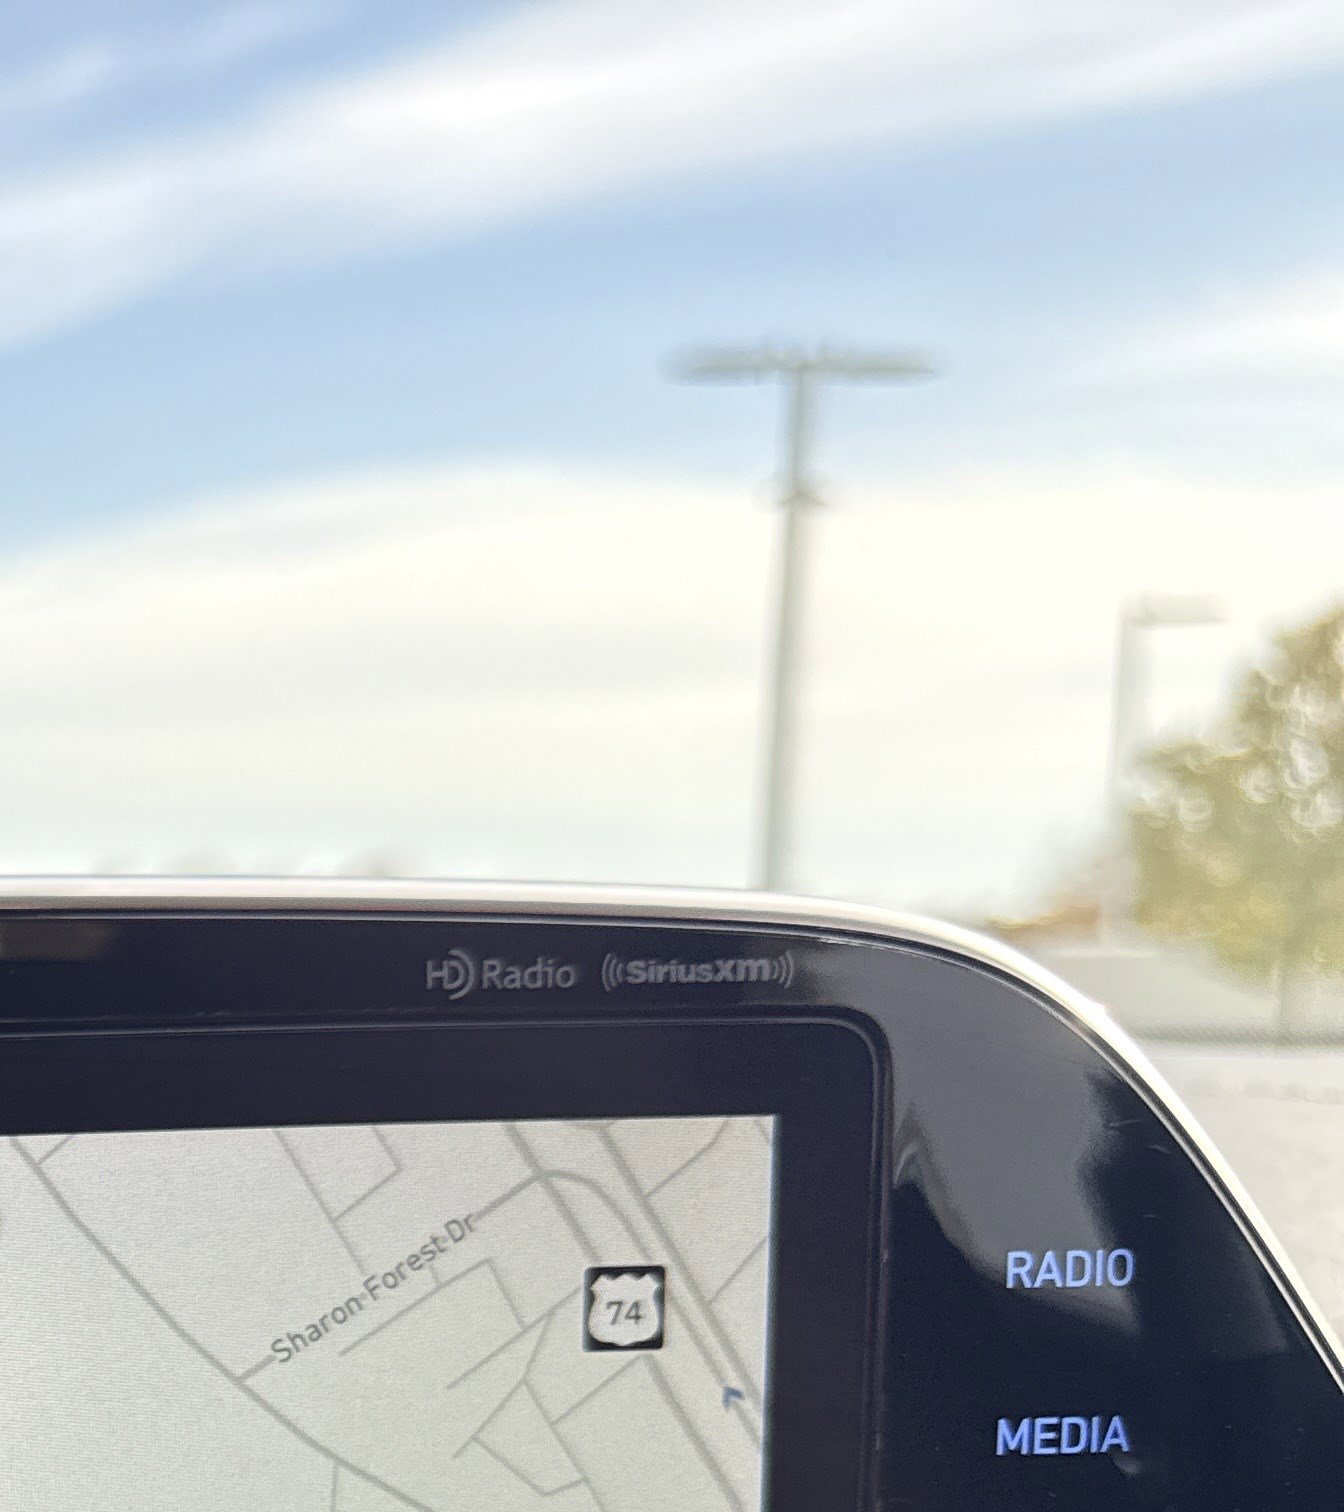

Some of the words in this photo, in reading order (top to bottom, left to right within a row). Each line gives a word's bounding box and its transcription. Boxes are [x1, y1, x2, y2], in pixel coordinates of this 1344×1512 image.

[481, 957, 576, 991] Radio
[270, 1296, 365, 1363] Sharon
[362, 1235, 447, 1301] Forest
[444, 1213, 477, 1243] Dr
[1005, 1248, 1136, 1289] RADIO
[606, 1300, 643, 1326] 74
[995, 1415, 1131, 1456] MEDIA
